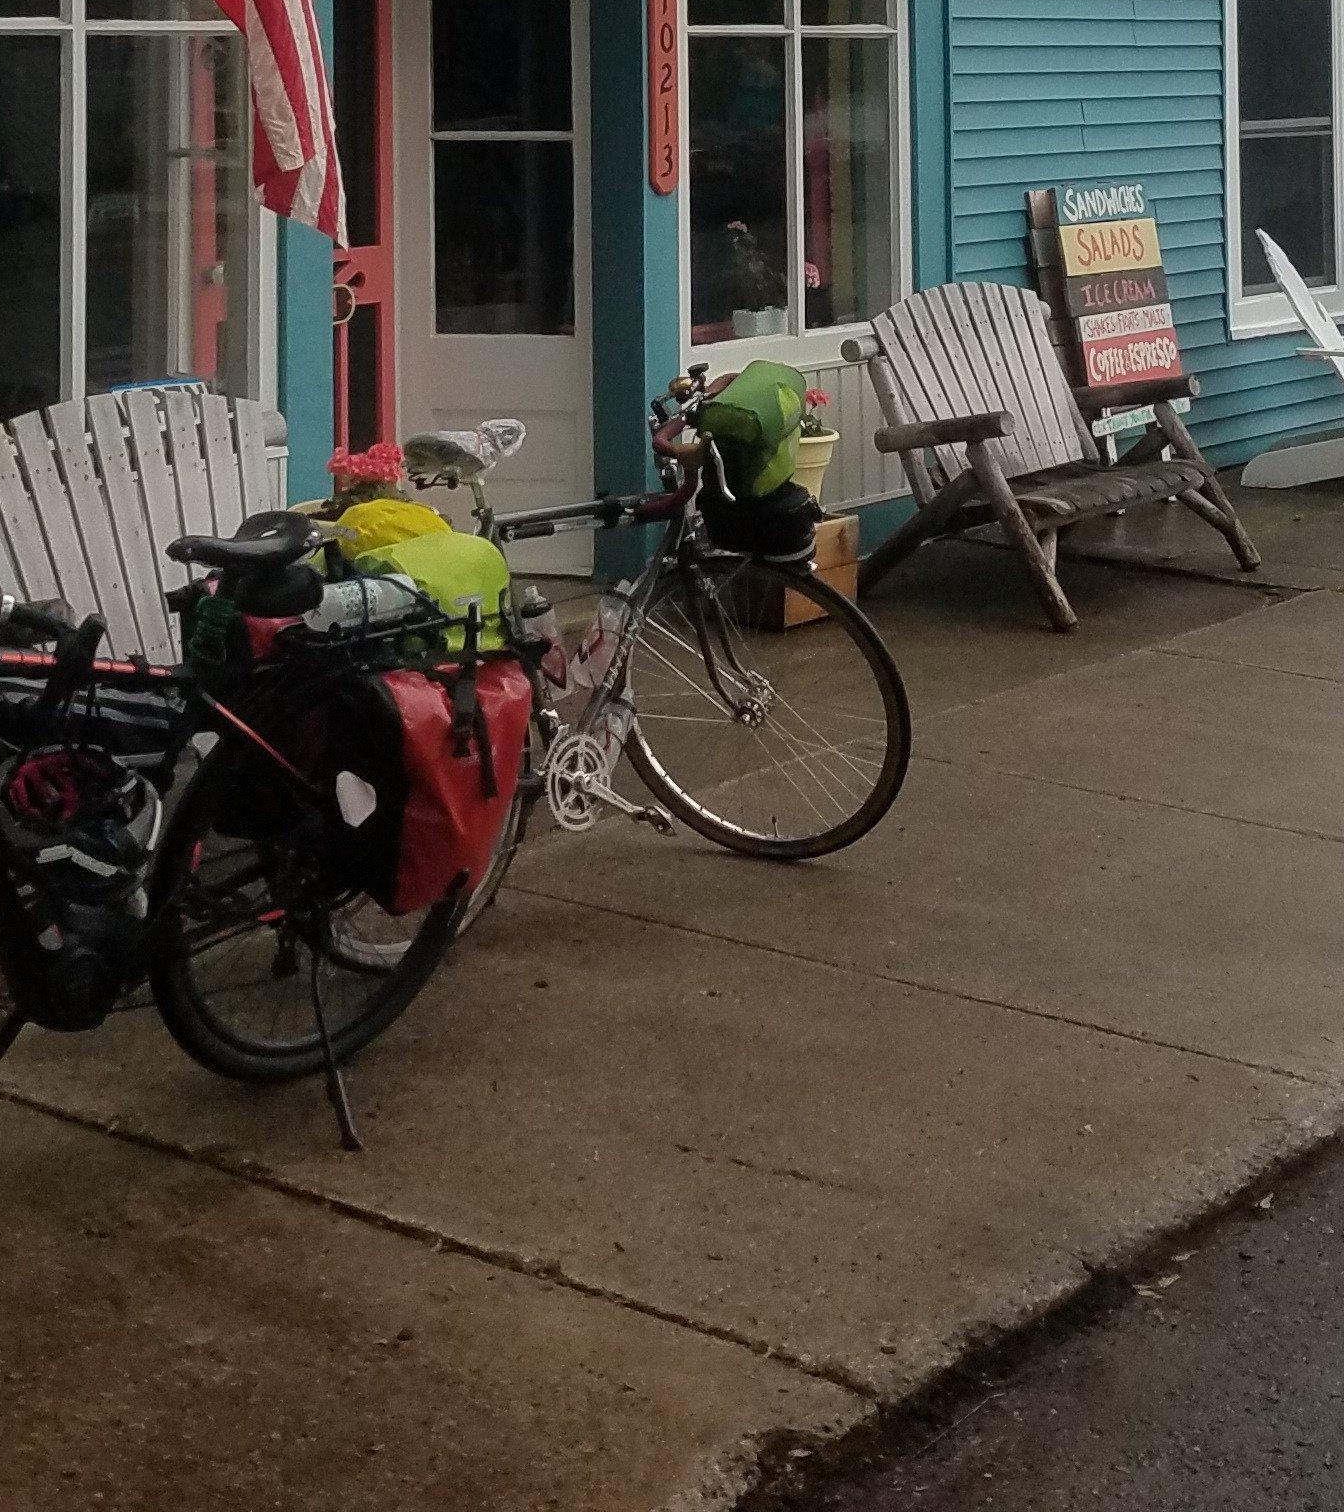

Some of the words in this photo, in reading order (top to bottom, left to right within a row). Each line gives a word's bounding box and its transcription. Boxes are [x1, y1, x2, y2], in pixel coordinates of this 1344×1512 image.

[1062, 183, 1146, 222] SANDWICHES
[1076, 224, 1145, 267] SALADS
[1081, 283, 1111, 307] ICE
[1113, 278, 1156, 305] CREAM
